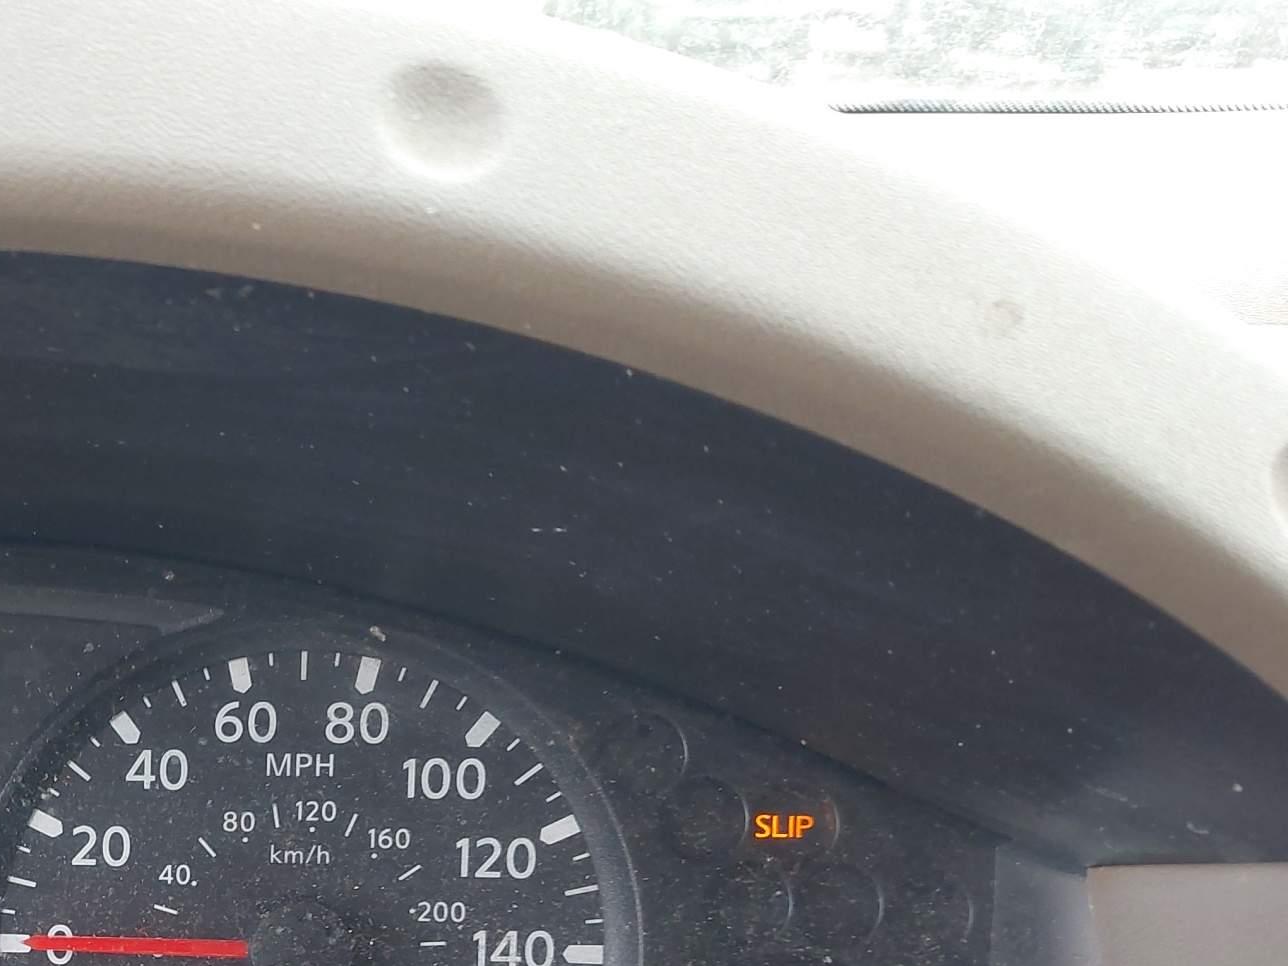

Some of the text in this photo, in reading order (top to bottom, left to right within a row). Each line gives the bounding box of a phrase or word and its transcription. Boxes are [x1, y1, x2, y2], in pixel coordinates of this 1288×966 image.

[214, 701, 277, 744] 60
[324, 701, 390, 745] 80
[124, 749, 189, 791] 40
[266, 752, 335, 778] MPH
[402, 757, 487, 801] 100
[222, 810, 256, 833] 80
[294, 800, 338, 823] 120
[367, 827, 411, 850] 160
[754, 813, 814, 839] SLIP
[70, 824, 131, 867] 20
[268, 844, 331, 866] km/h
[455, 836, 537, 880] 120
[158, 863, 192, 885] 40
[416, 901, 467, 923] 200
[46, 924, 74, 965] 0
